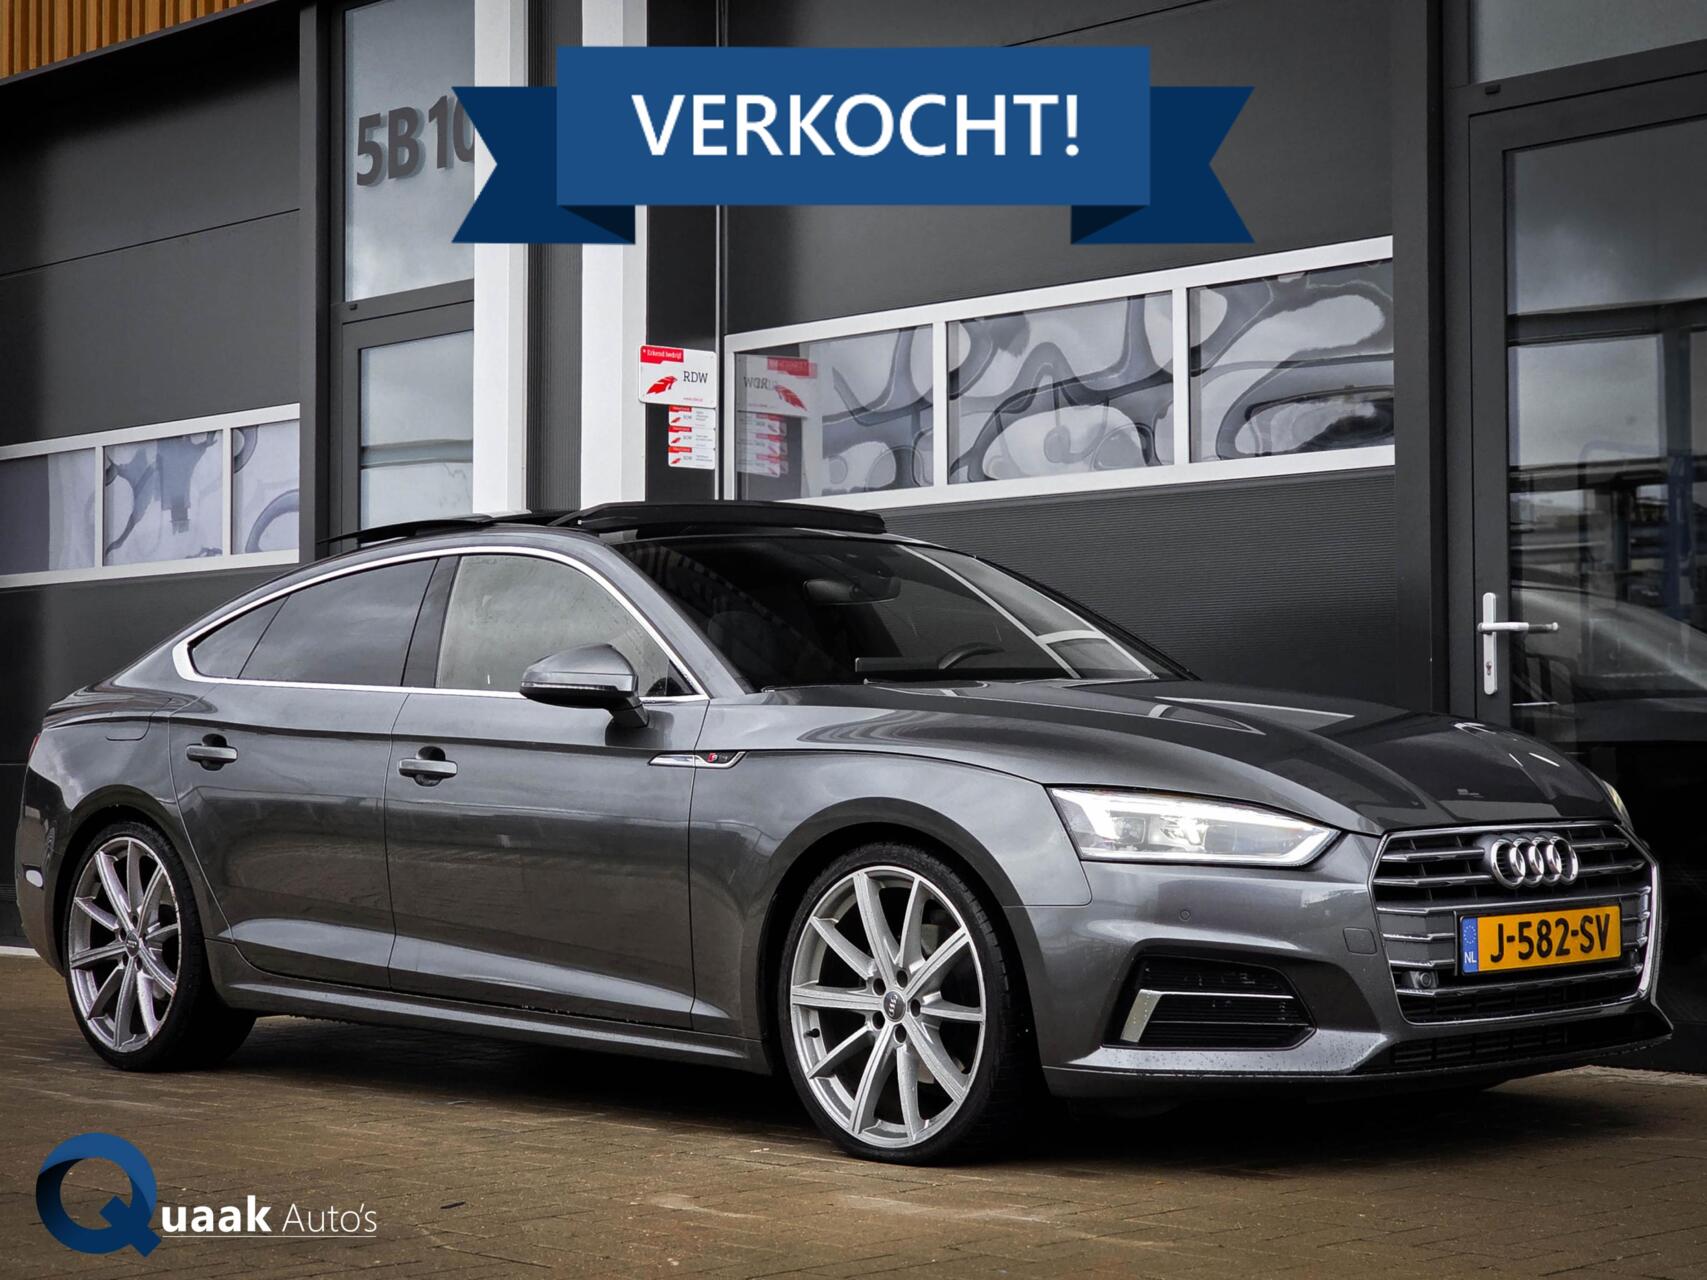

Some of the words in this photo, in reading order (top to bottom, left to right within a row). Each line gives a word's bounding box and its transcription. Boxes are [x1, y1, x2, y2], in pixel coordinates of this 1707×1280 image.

[683, 370, 708, 384] RDW
[1490, 913, 1610, 963] J-582-SV
[1464, 951, 1477, 964] NL
